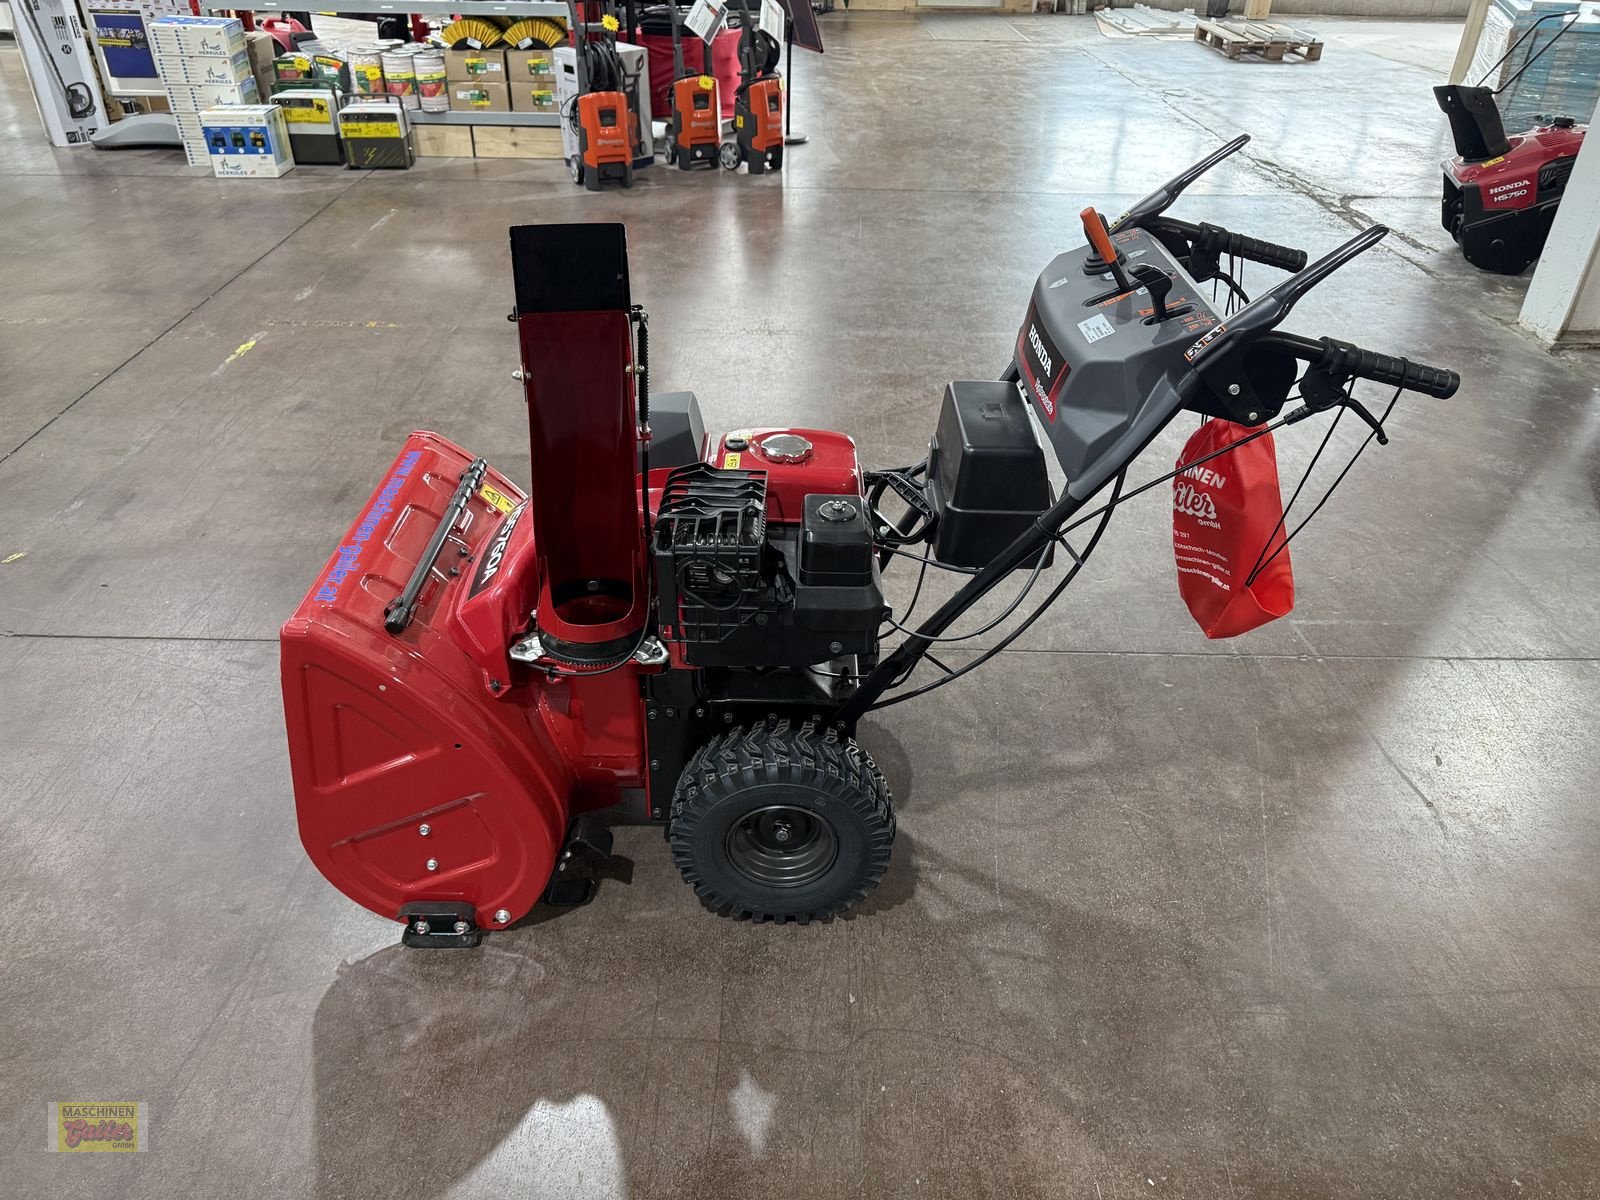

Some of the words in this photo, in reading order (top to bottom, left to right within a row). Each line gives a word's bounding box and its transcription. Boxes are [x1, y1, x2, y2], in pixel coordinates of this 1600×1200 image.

[1488, 179, 1532, 195] HONDA
[1493, 189, 1528, 203] HS750
[1028, 324, 1052, 378] HONDA
[314, 450, 422, 602] www.maschinen-gailer.at
